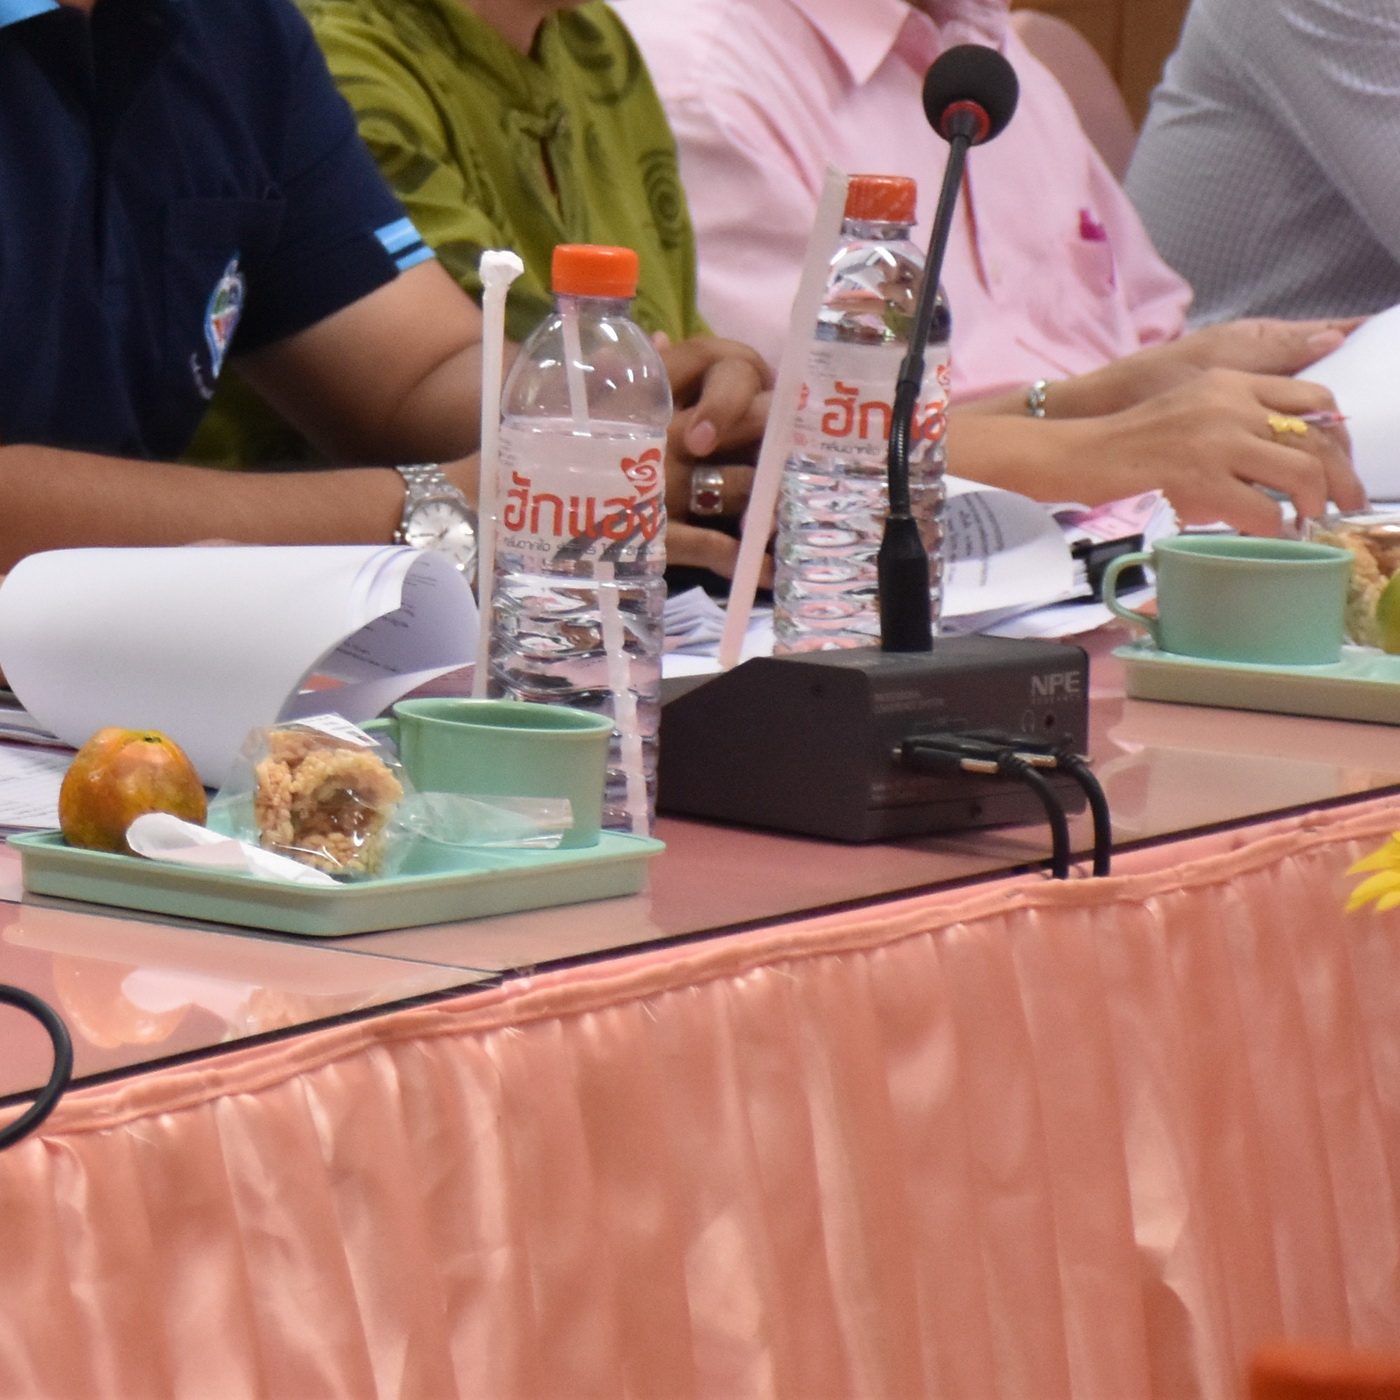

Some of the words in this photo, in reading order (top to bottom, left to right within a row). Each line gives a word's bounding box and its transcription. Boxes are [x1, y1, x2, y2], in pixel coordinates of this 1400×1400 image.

[503, 471, 661, 541] ฮักแฮง
[1031, 671, 1081, 696] NPE
